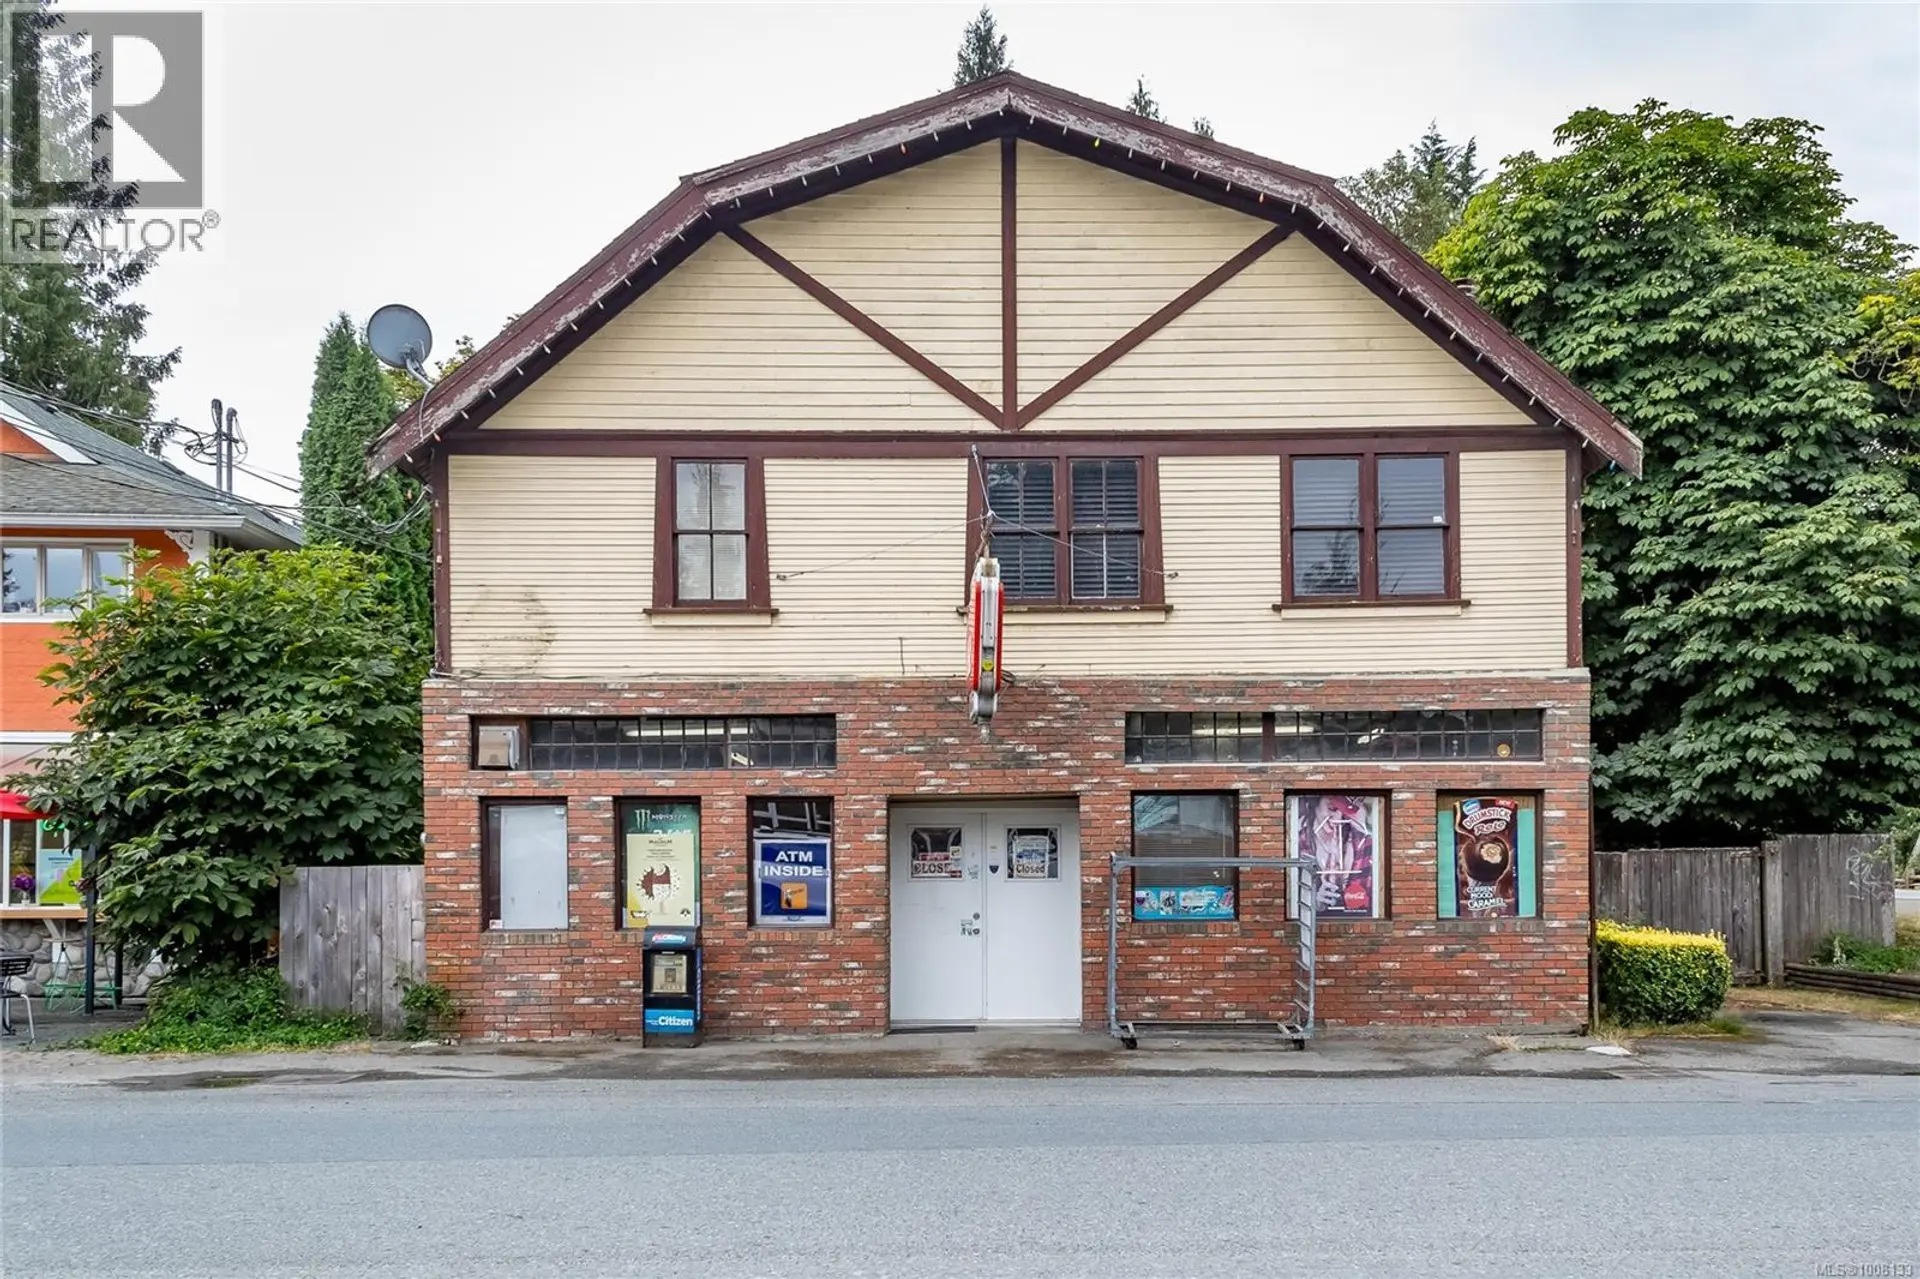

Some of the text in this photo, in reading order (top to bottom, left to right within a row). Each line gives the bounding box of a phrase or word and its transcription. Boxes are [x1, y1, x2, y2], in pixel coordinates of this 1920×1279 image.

[1463, 808, 1511, 829] DRUMSTICK
[775, 851, 813, 862] ATM
[764, 865, 824, 876] INSIDE
[1016, 864, 1046, 874] Closed
[1468, 898, 1504, 909] CARAMEL
[658, 1016, 693, 1026] Citizen
